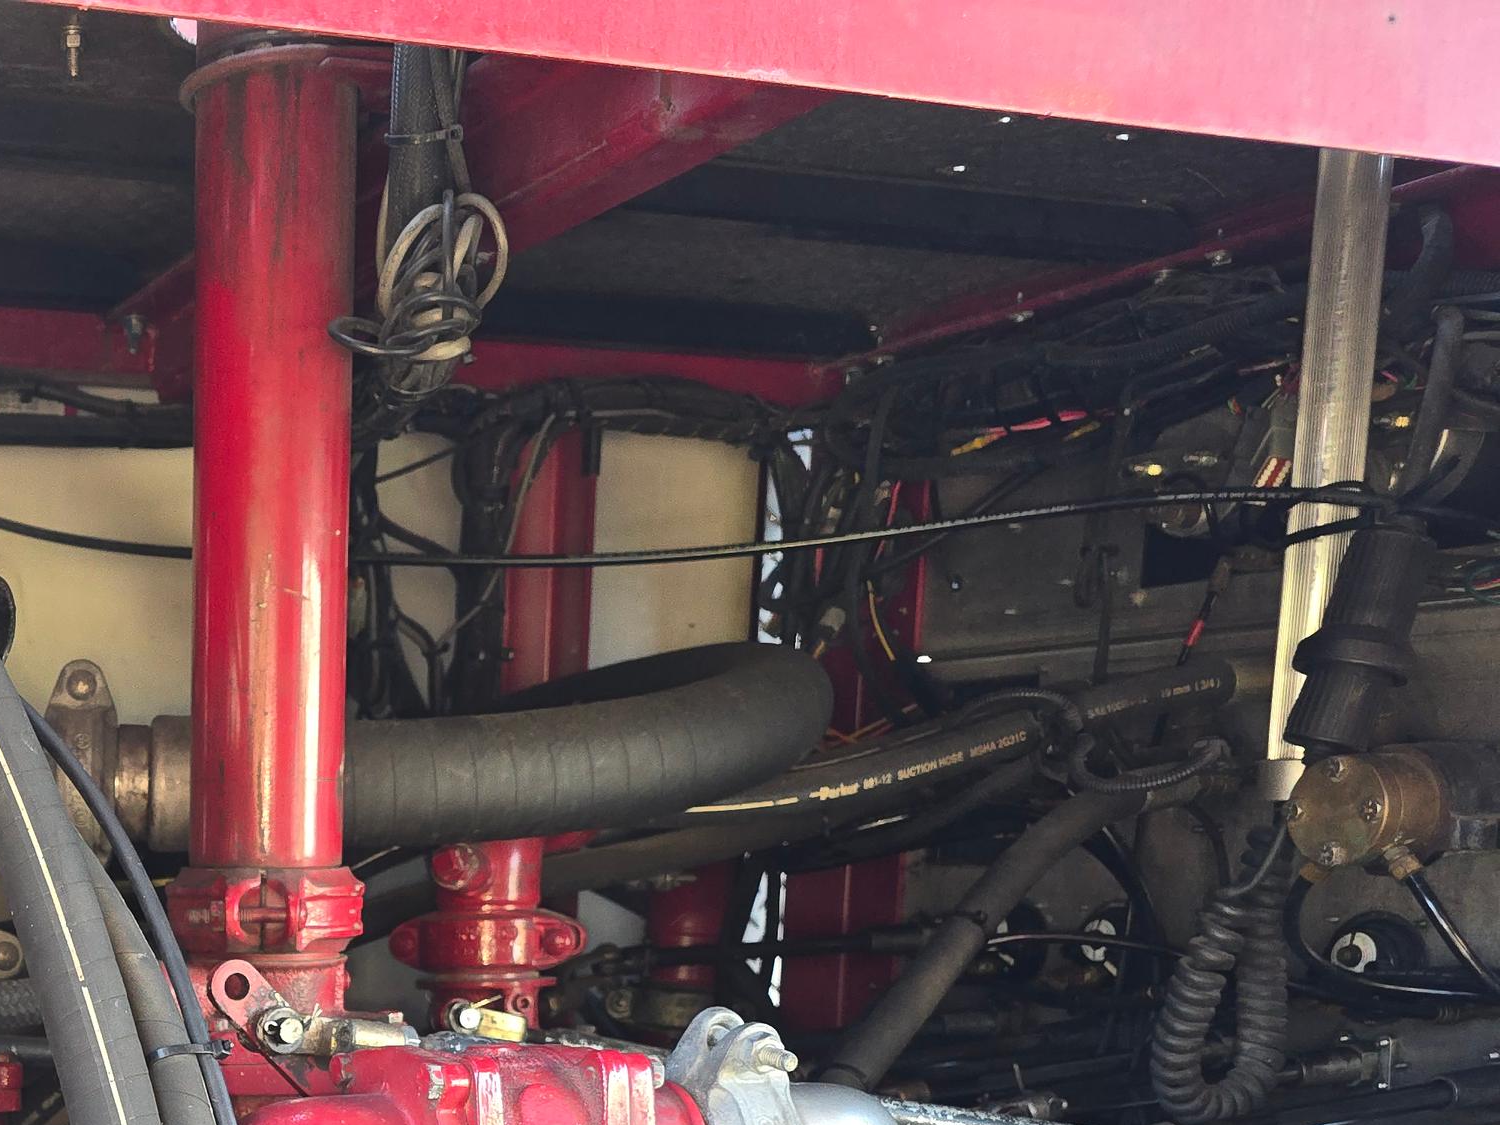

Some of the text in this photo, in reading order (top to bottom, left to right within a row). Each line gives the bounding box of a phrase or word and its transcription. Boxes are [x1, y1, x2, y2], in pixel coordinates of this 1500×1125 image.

[809, 781, 860, 801] Parker
[897, 759, 939, 781] SUCTION
[938, 750, 964, 769] HOSE
[969, 740, 997, 759] MSHA
